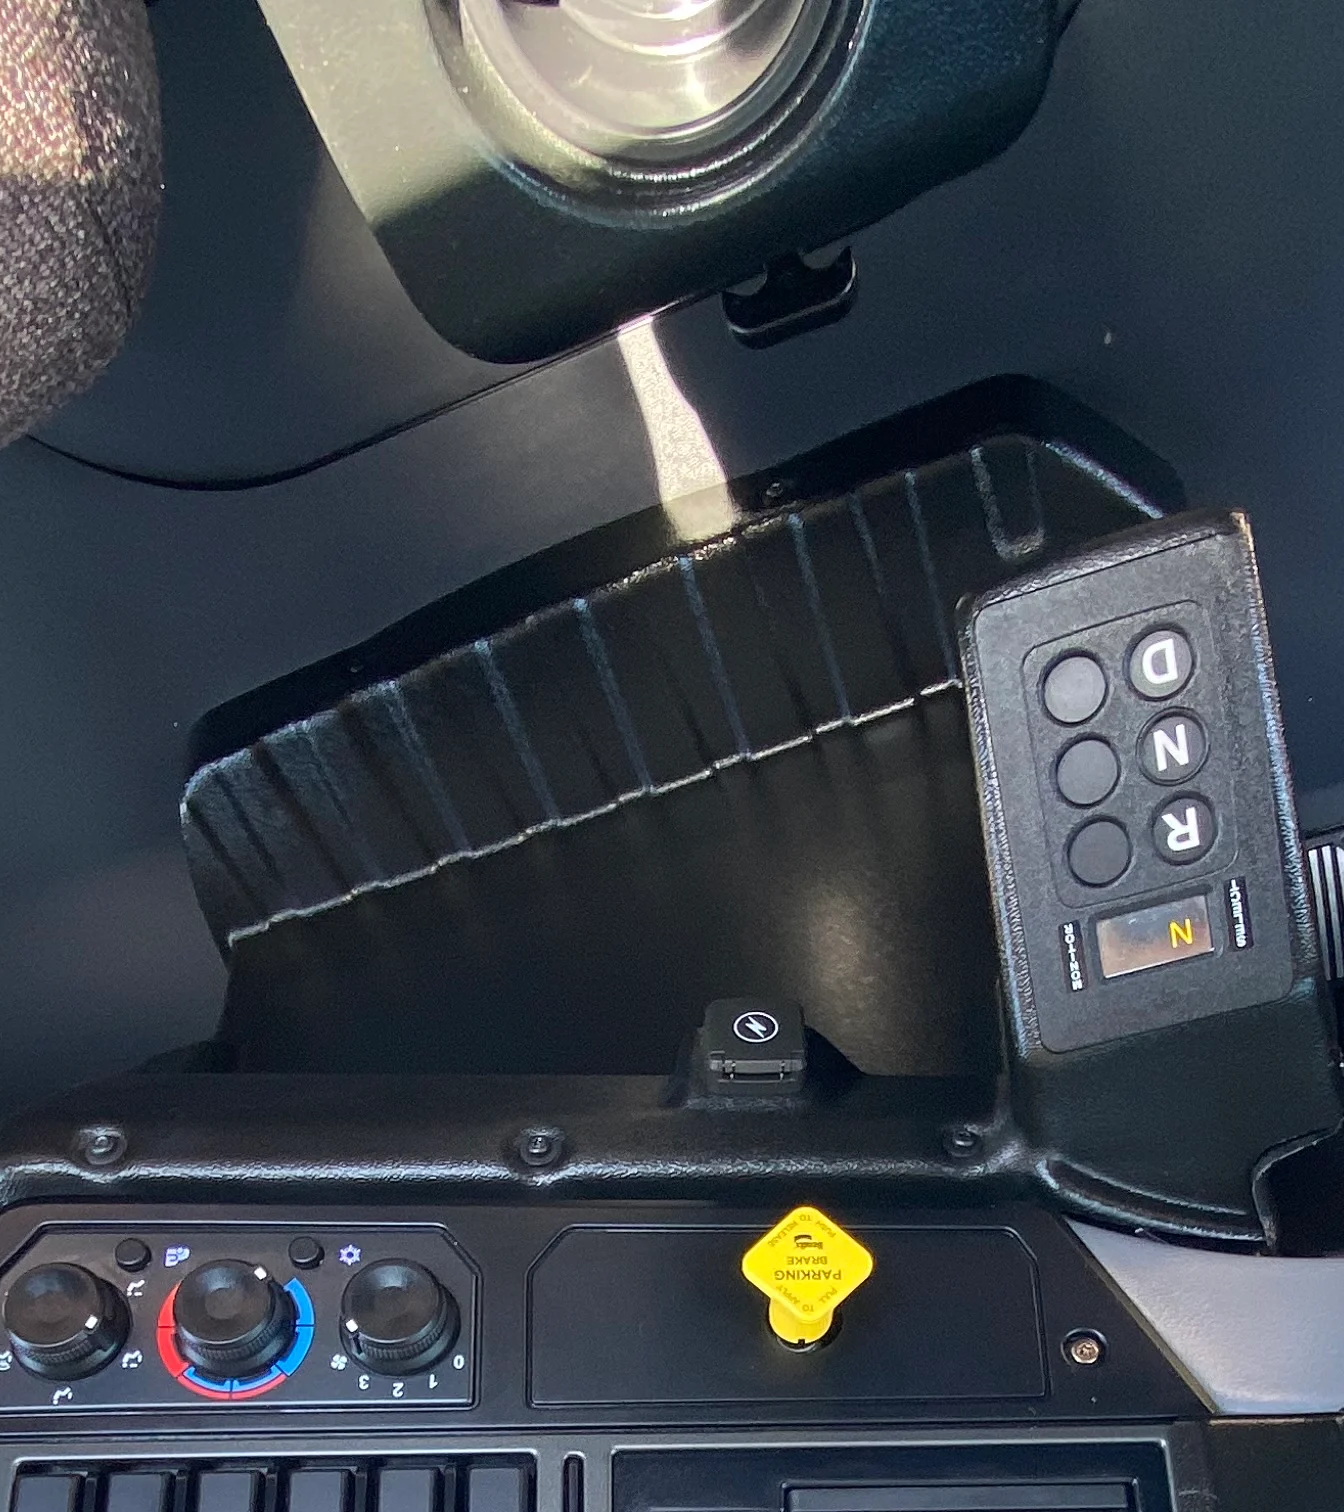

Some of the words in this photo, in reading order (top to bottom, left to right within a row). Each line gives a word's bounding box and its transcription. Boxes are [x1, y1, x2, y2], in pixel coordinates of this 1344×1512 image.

[1141, 638, 1178, 685] D
[1151, 723, 1190, 772] N
[1161, 806, 1201, 853] R
[1228, 879, 1247, 947] SELECT
[1168, 918, 1193, 949] N
[1063, 923, 1083, 991] MONITOR
[799, 1214, 812, 1222] TO
[767, 1220, 798, 1248] RELEASE
[815, 1220, 836, 1239] PUSH
[787, 1256, 828, 1265] BRAKE
[774, 1269, 842, 1281] PARKING
[775, 1285, 800, 1305] APPLY
[818, 1286, 838, 1304] PULL
[802, 1304, 815, 1312] TO
[358, 1375, 369, 1389] 3
[393, 1383, 404, 1397] 2
[429, 1375, 437, 1388] 1
